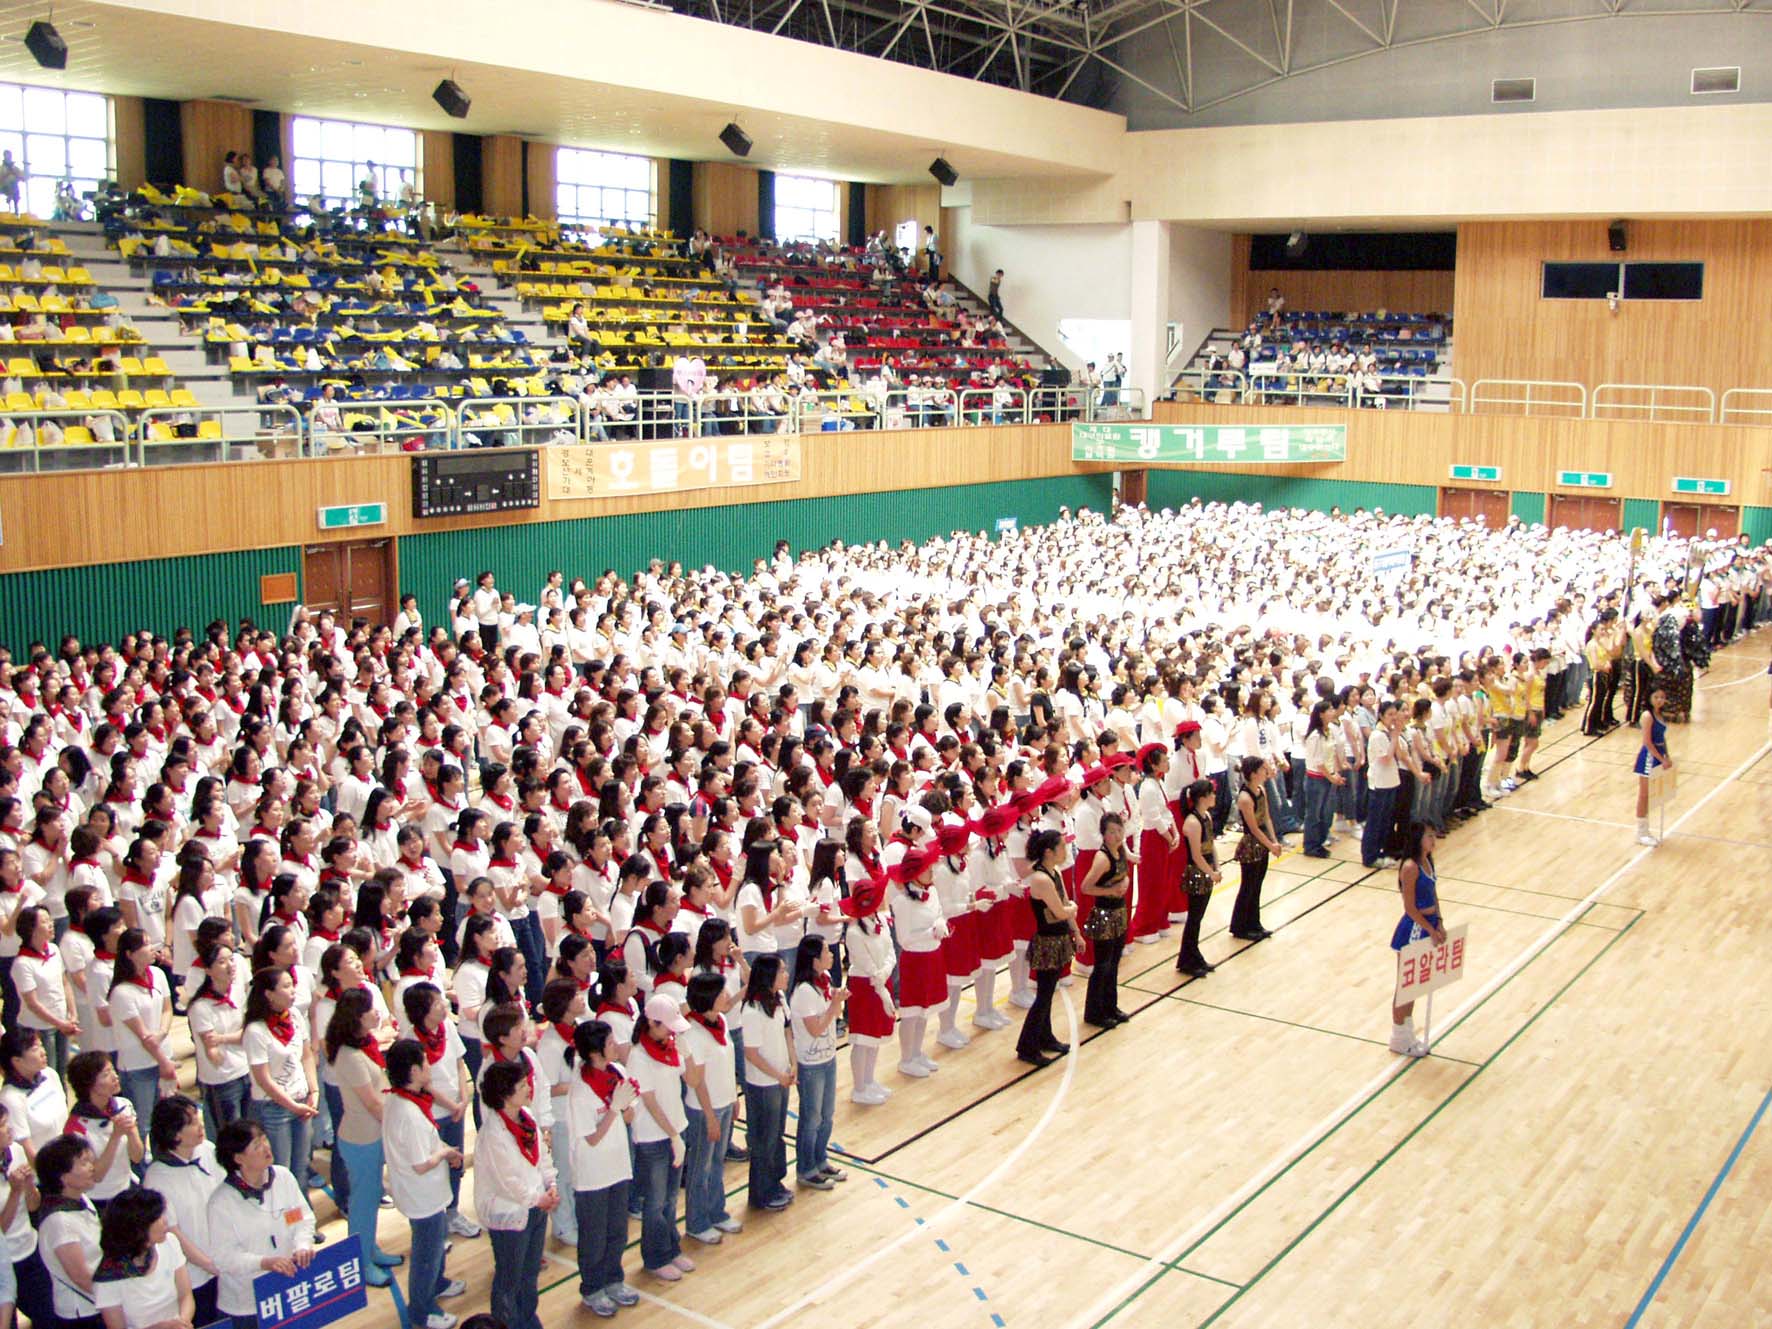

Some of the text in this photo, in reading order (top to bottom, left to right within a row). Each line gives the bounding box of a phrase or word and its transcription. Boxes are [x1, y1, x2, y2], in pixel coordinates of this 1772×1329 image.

[1129, 428, 1289, 460] 캥거루팀
[1403, 938, 1464, 988] 코알라팀
[260, 1257, 361, 1321] 버팔로팀
